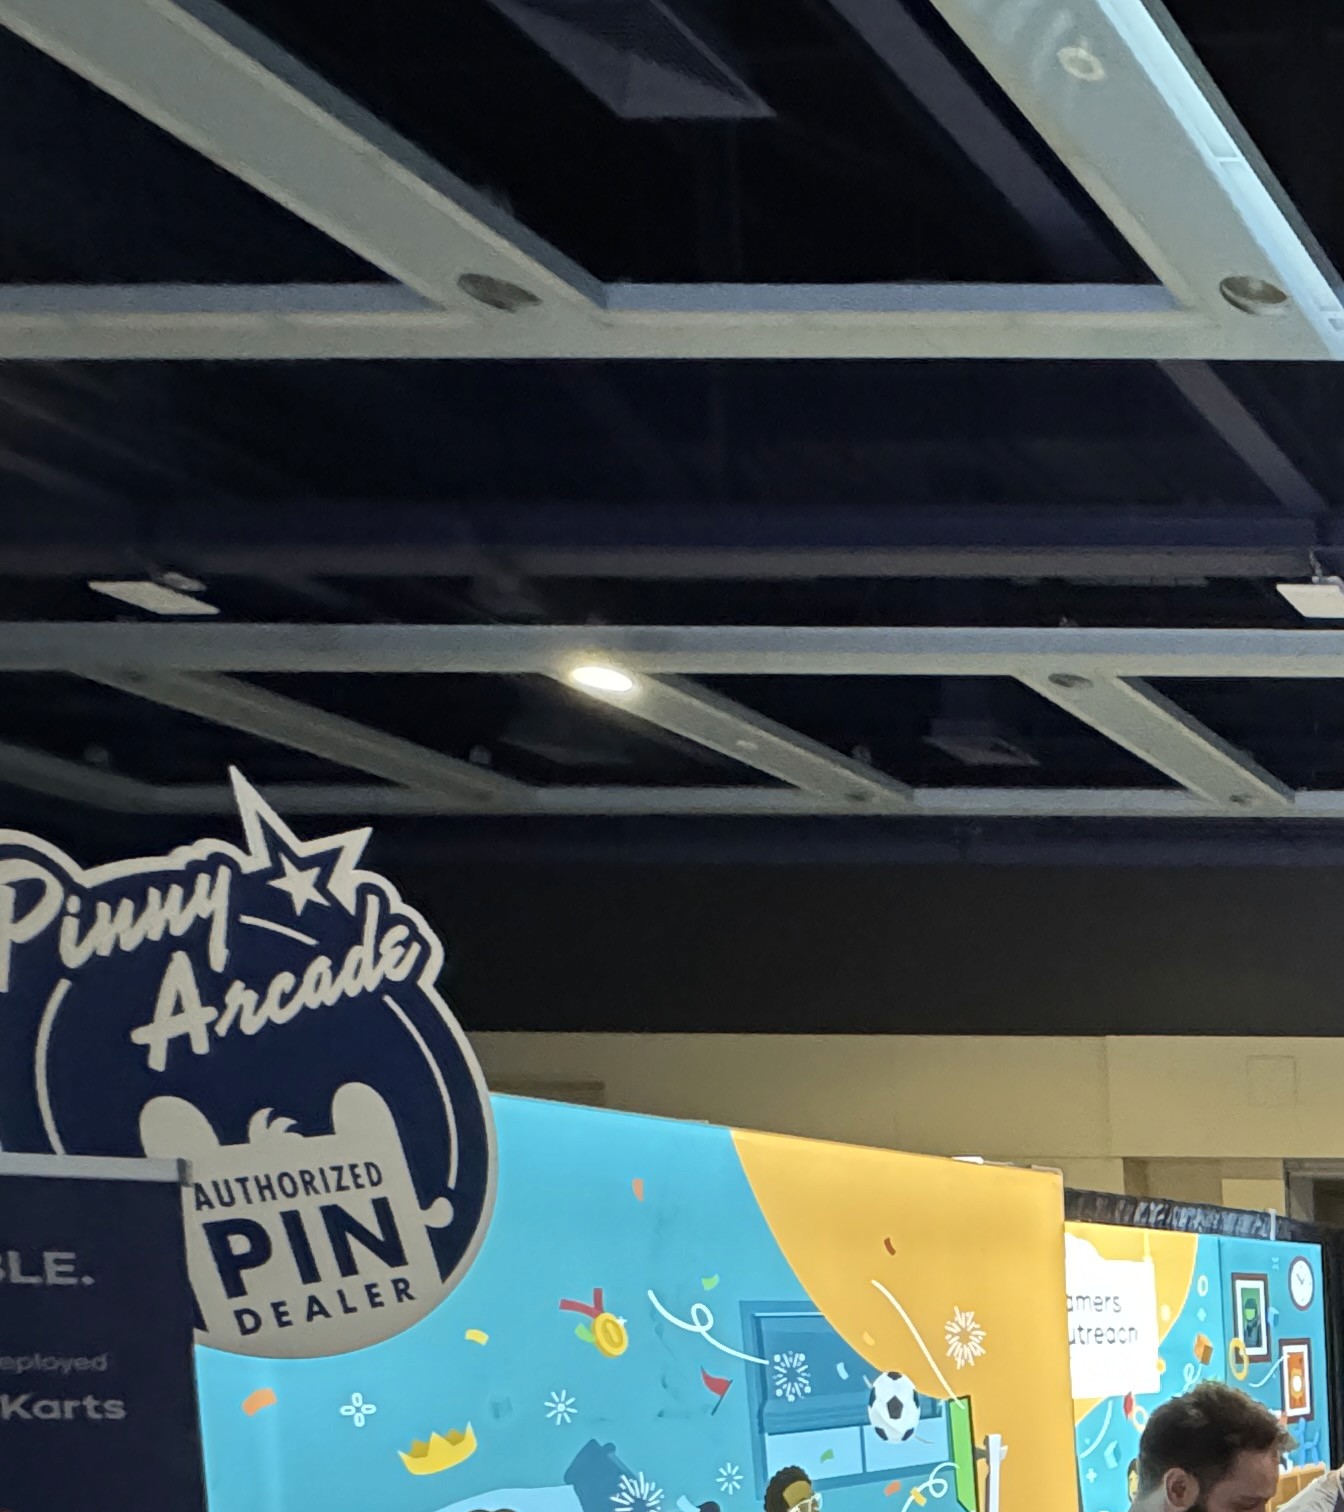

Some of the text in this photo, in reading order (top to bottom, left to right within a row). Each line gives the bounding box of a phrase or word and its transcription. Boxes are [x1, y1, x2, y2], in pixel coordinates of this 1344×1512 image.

[130, 893, 430, 1072] Arcade
[192, 1160, 384, 1211] AUTHORIZED
[0, 1250, 95, 1286] LE.
[201, 1196, 409, 1300] PIN
[233, 1278, 418, 1336] DEALER
[2, 1394, 128, 1422] Karts
